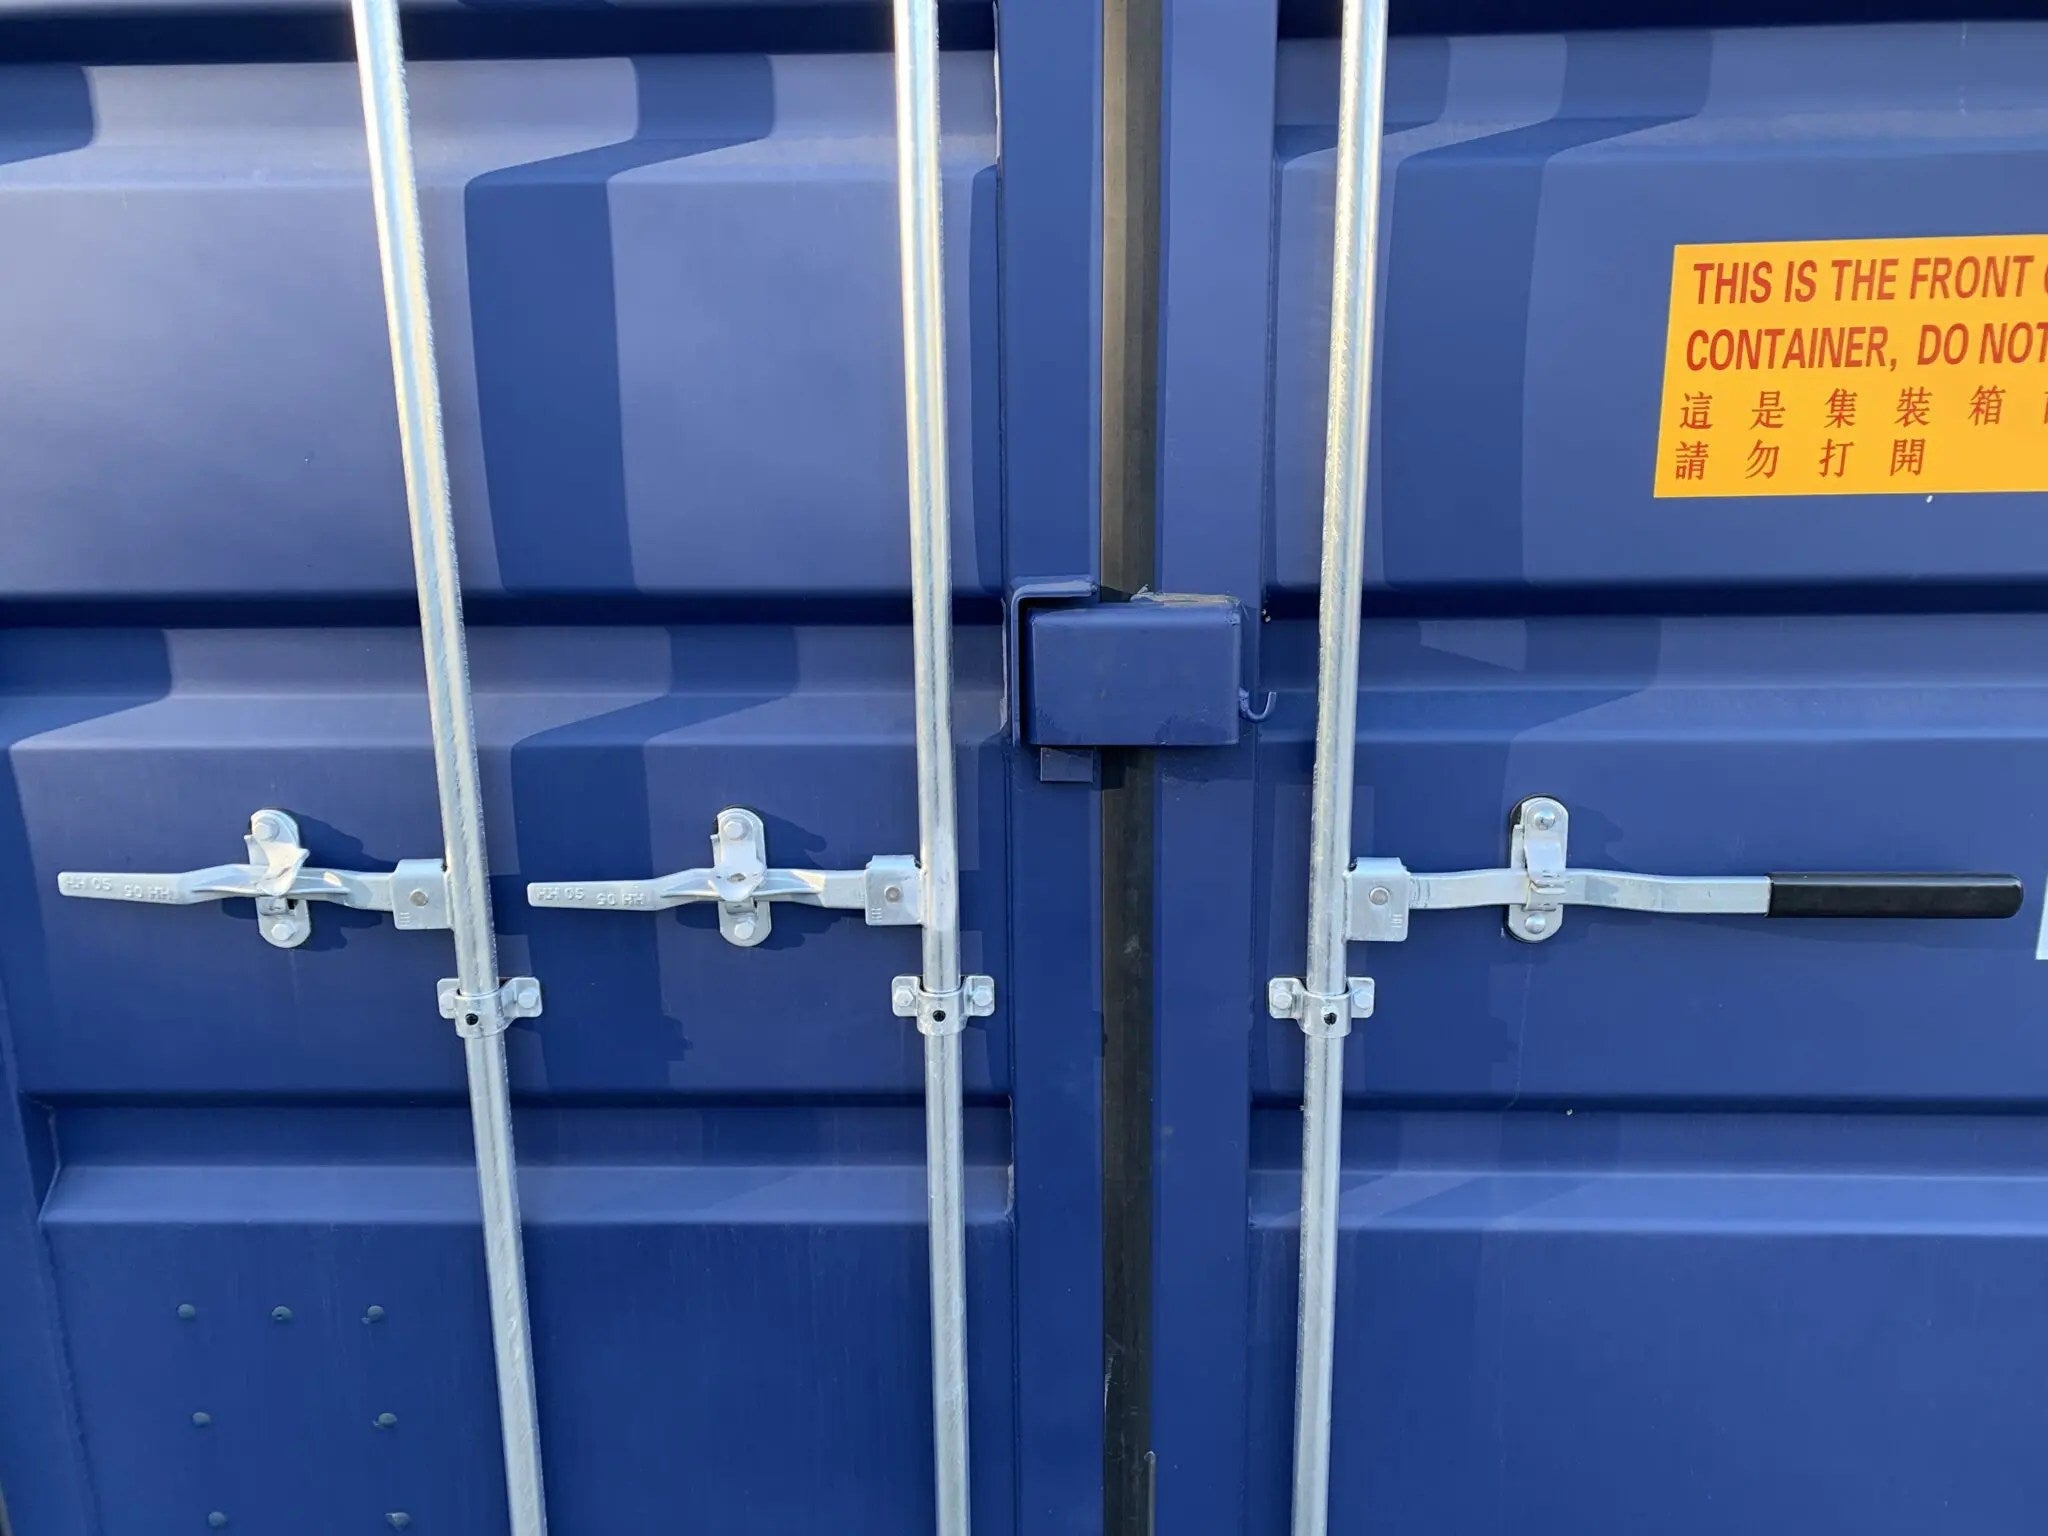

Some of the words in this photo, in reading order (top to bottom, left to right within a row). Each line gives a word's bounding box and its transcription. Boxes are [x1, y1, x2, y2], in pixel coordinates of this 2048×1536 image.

[1693, 260, 1773, 305] THIS
[1784, 259, 1818, 304] IS
[1831, 258, 1899, 302] THE
[1909, 255, 2036, 301] FRONT
[1686, 326, 1898, 373] CONTAINER,
[1917, 323, 1970, 366] DO
